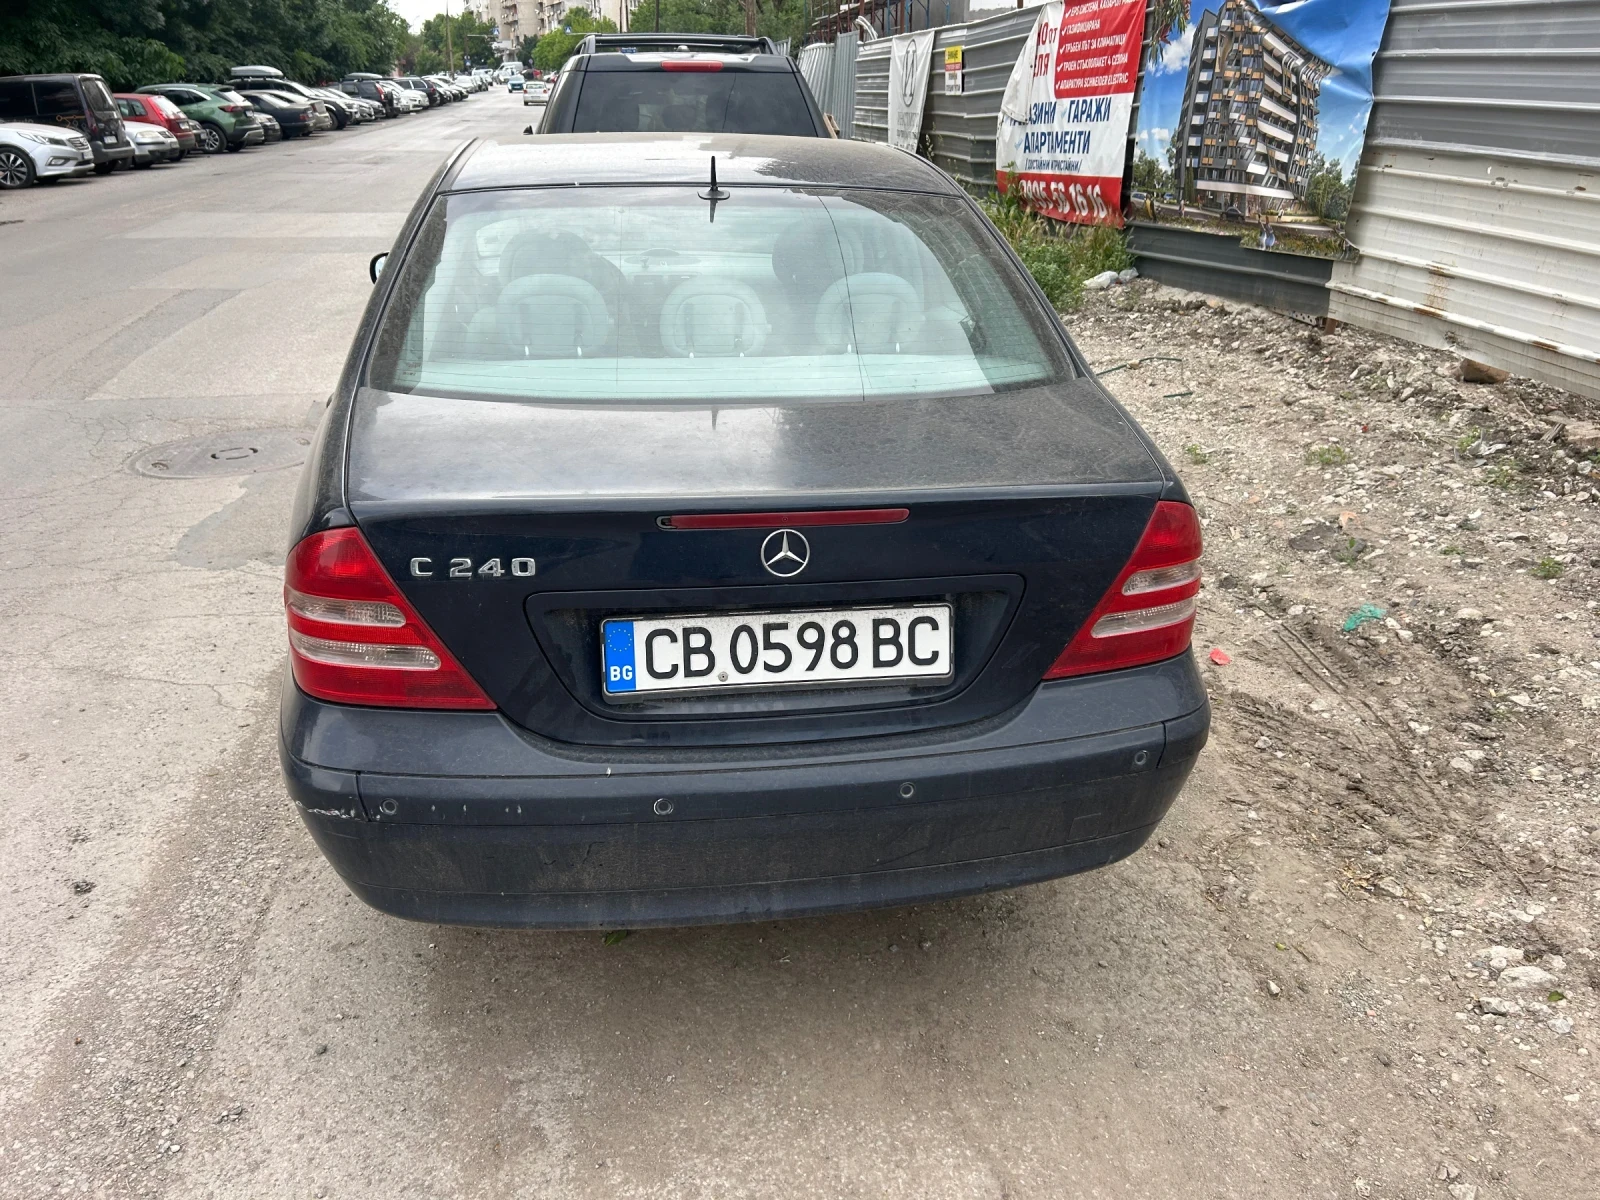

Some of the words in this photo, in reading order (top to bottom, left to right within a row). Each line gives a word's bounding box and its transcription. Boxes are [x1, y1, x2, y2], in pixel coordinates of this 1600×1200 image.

[1091, 38, 1096, 49] ЗА
[1067, 97, 1112, 123] ГАРАЖИ
[1023, 130, 1091, 154] АПАРТАМЕНТИ
[1069, 183, 1088, 216] 16
[1087, 184, 1107, 218] 16
[410, 557, 433, 577] C
[450, 557, 536, 578] 240
[645, 627, 716, 679] CB
[730, 619, 859, 675] 0598
[872, 616, 939, 668] BC
[610, 665, 633, 682] BG
